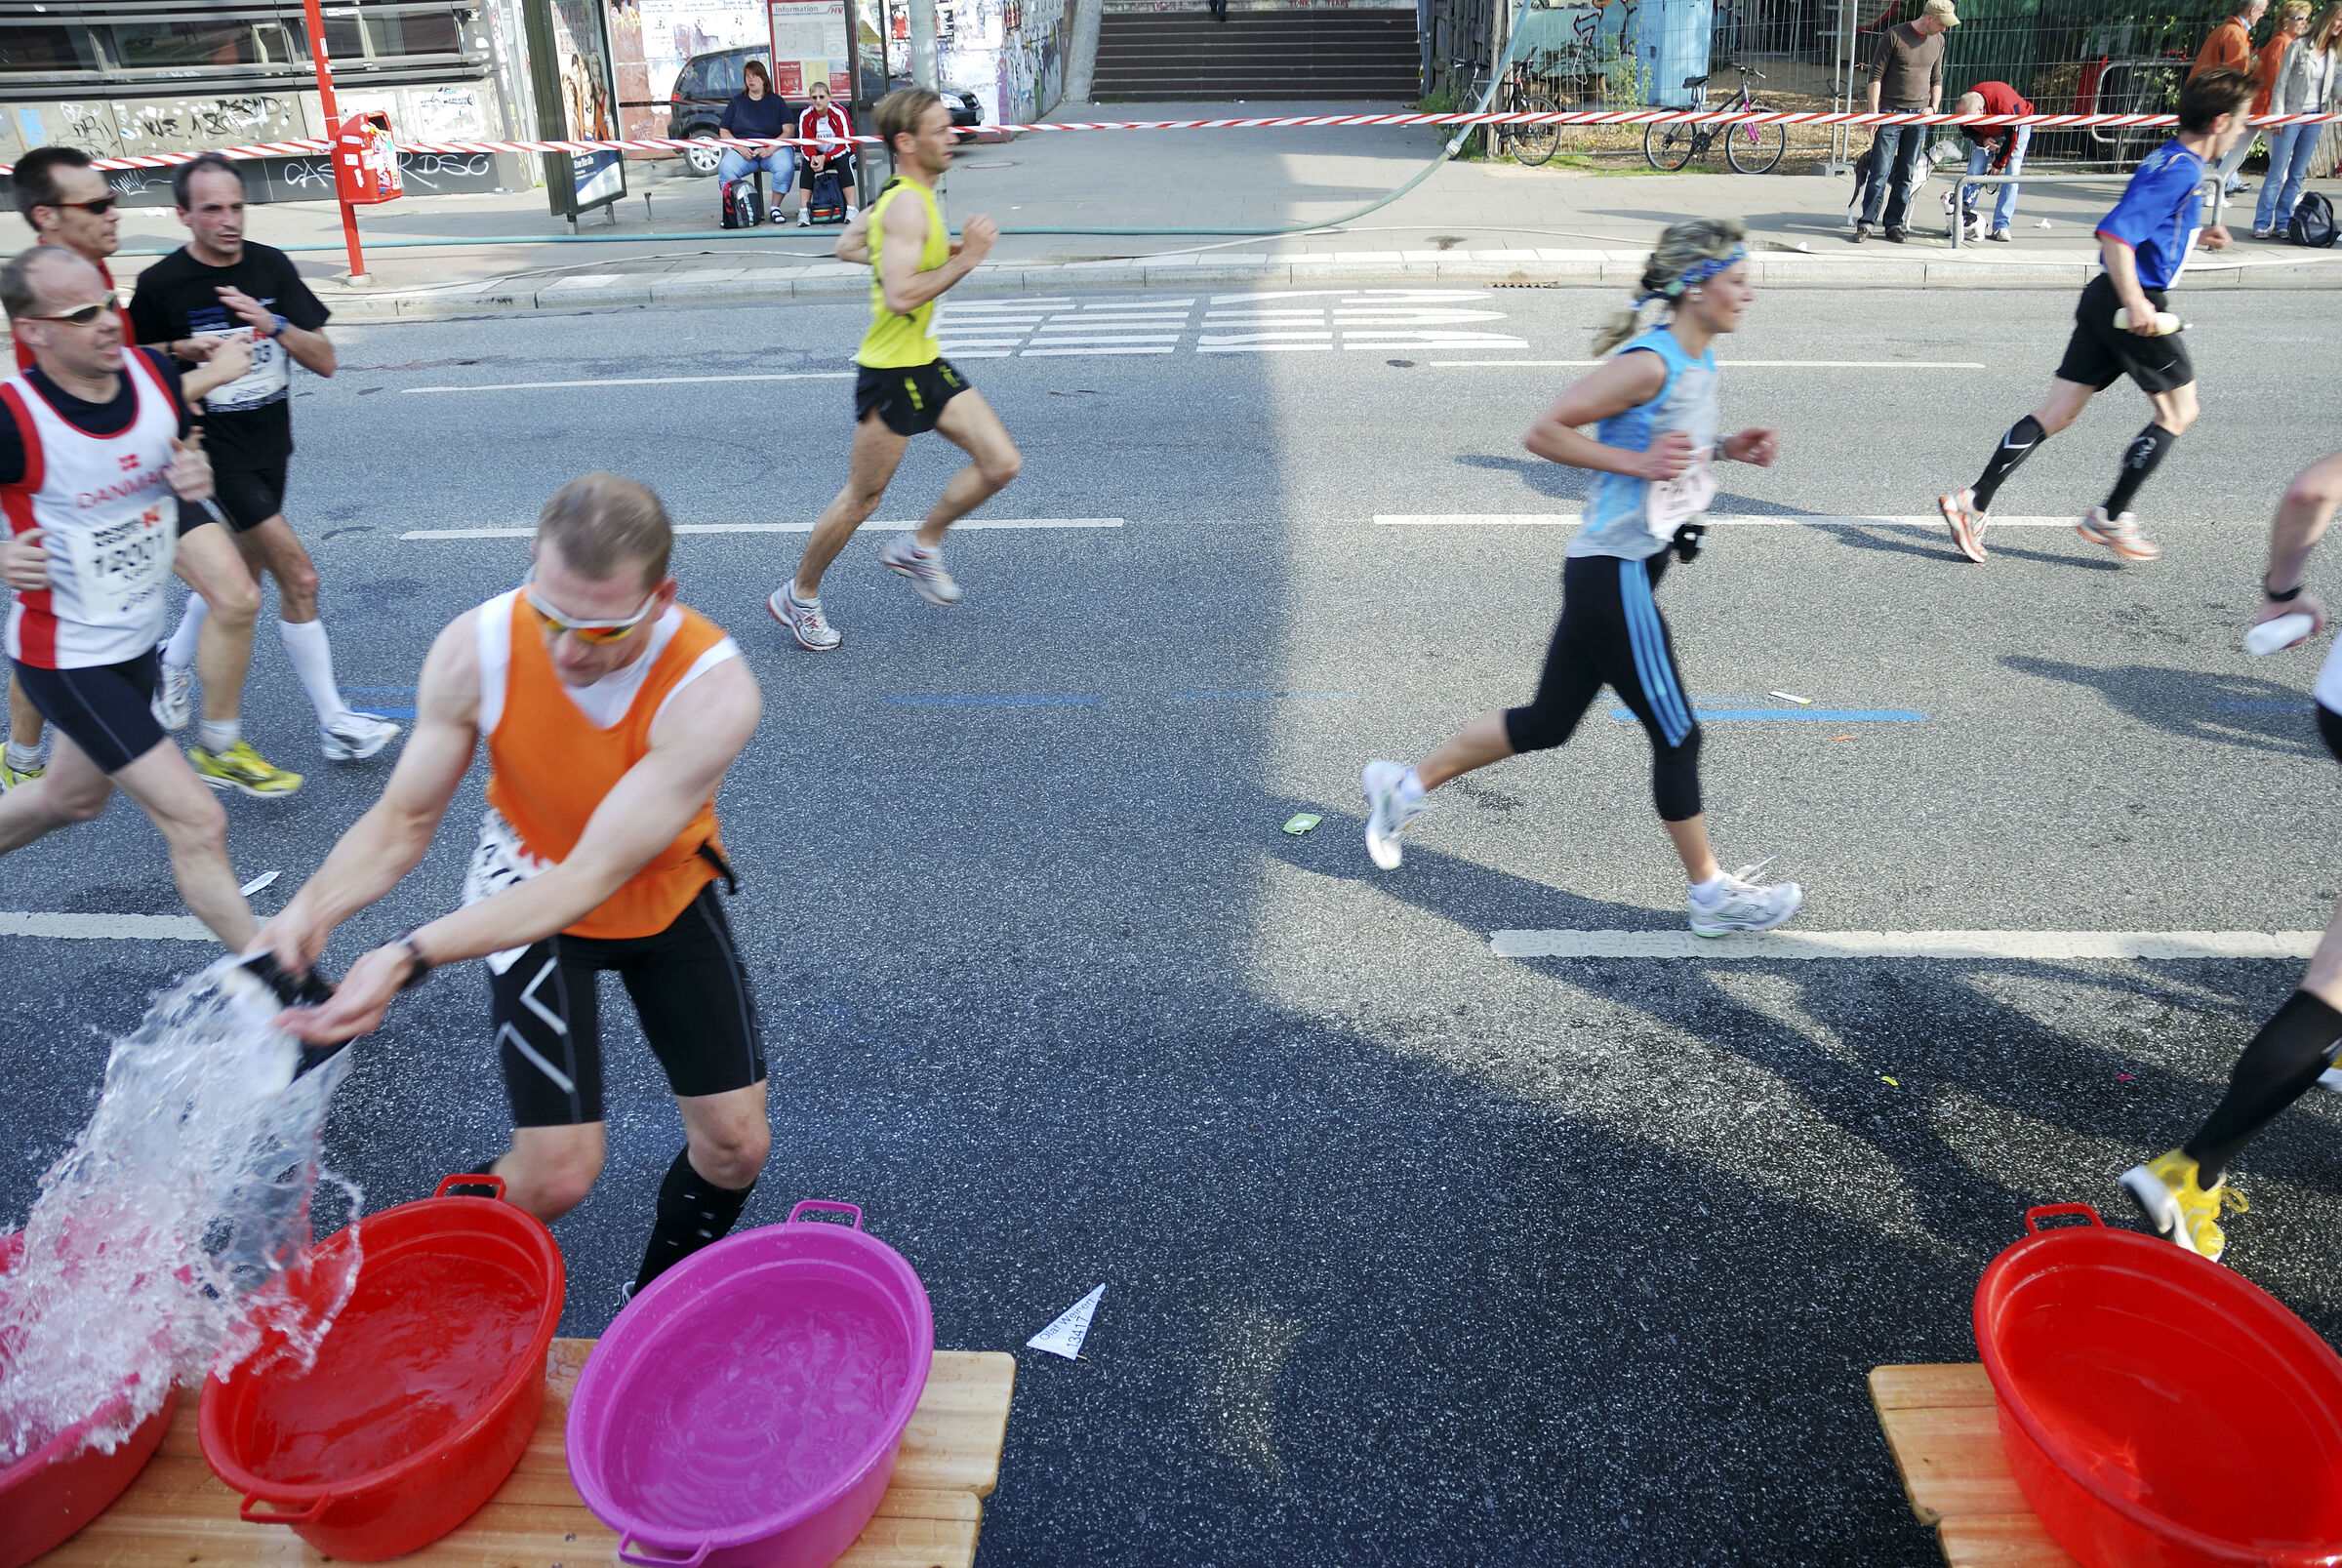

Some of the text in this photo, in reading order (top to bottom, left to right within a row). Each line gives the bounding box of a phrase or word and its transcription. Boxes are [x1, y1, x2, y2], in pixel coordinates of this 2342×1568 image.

[775, 5, 819, 14] Information
[1039, 1298, 1096, 1341] Olaf Weinert
[1067, 1315, 1090, 1348] 13417
